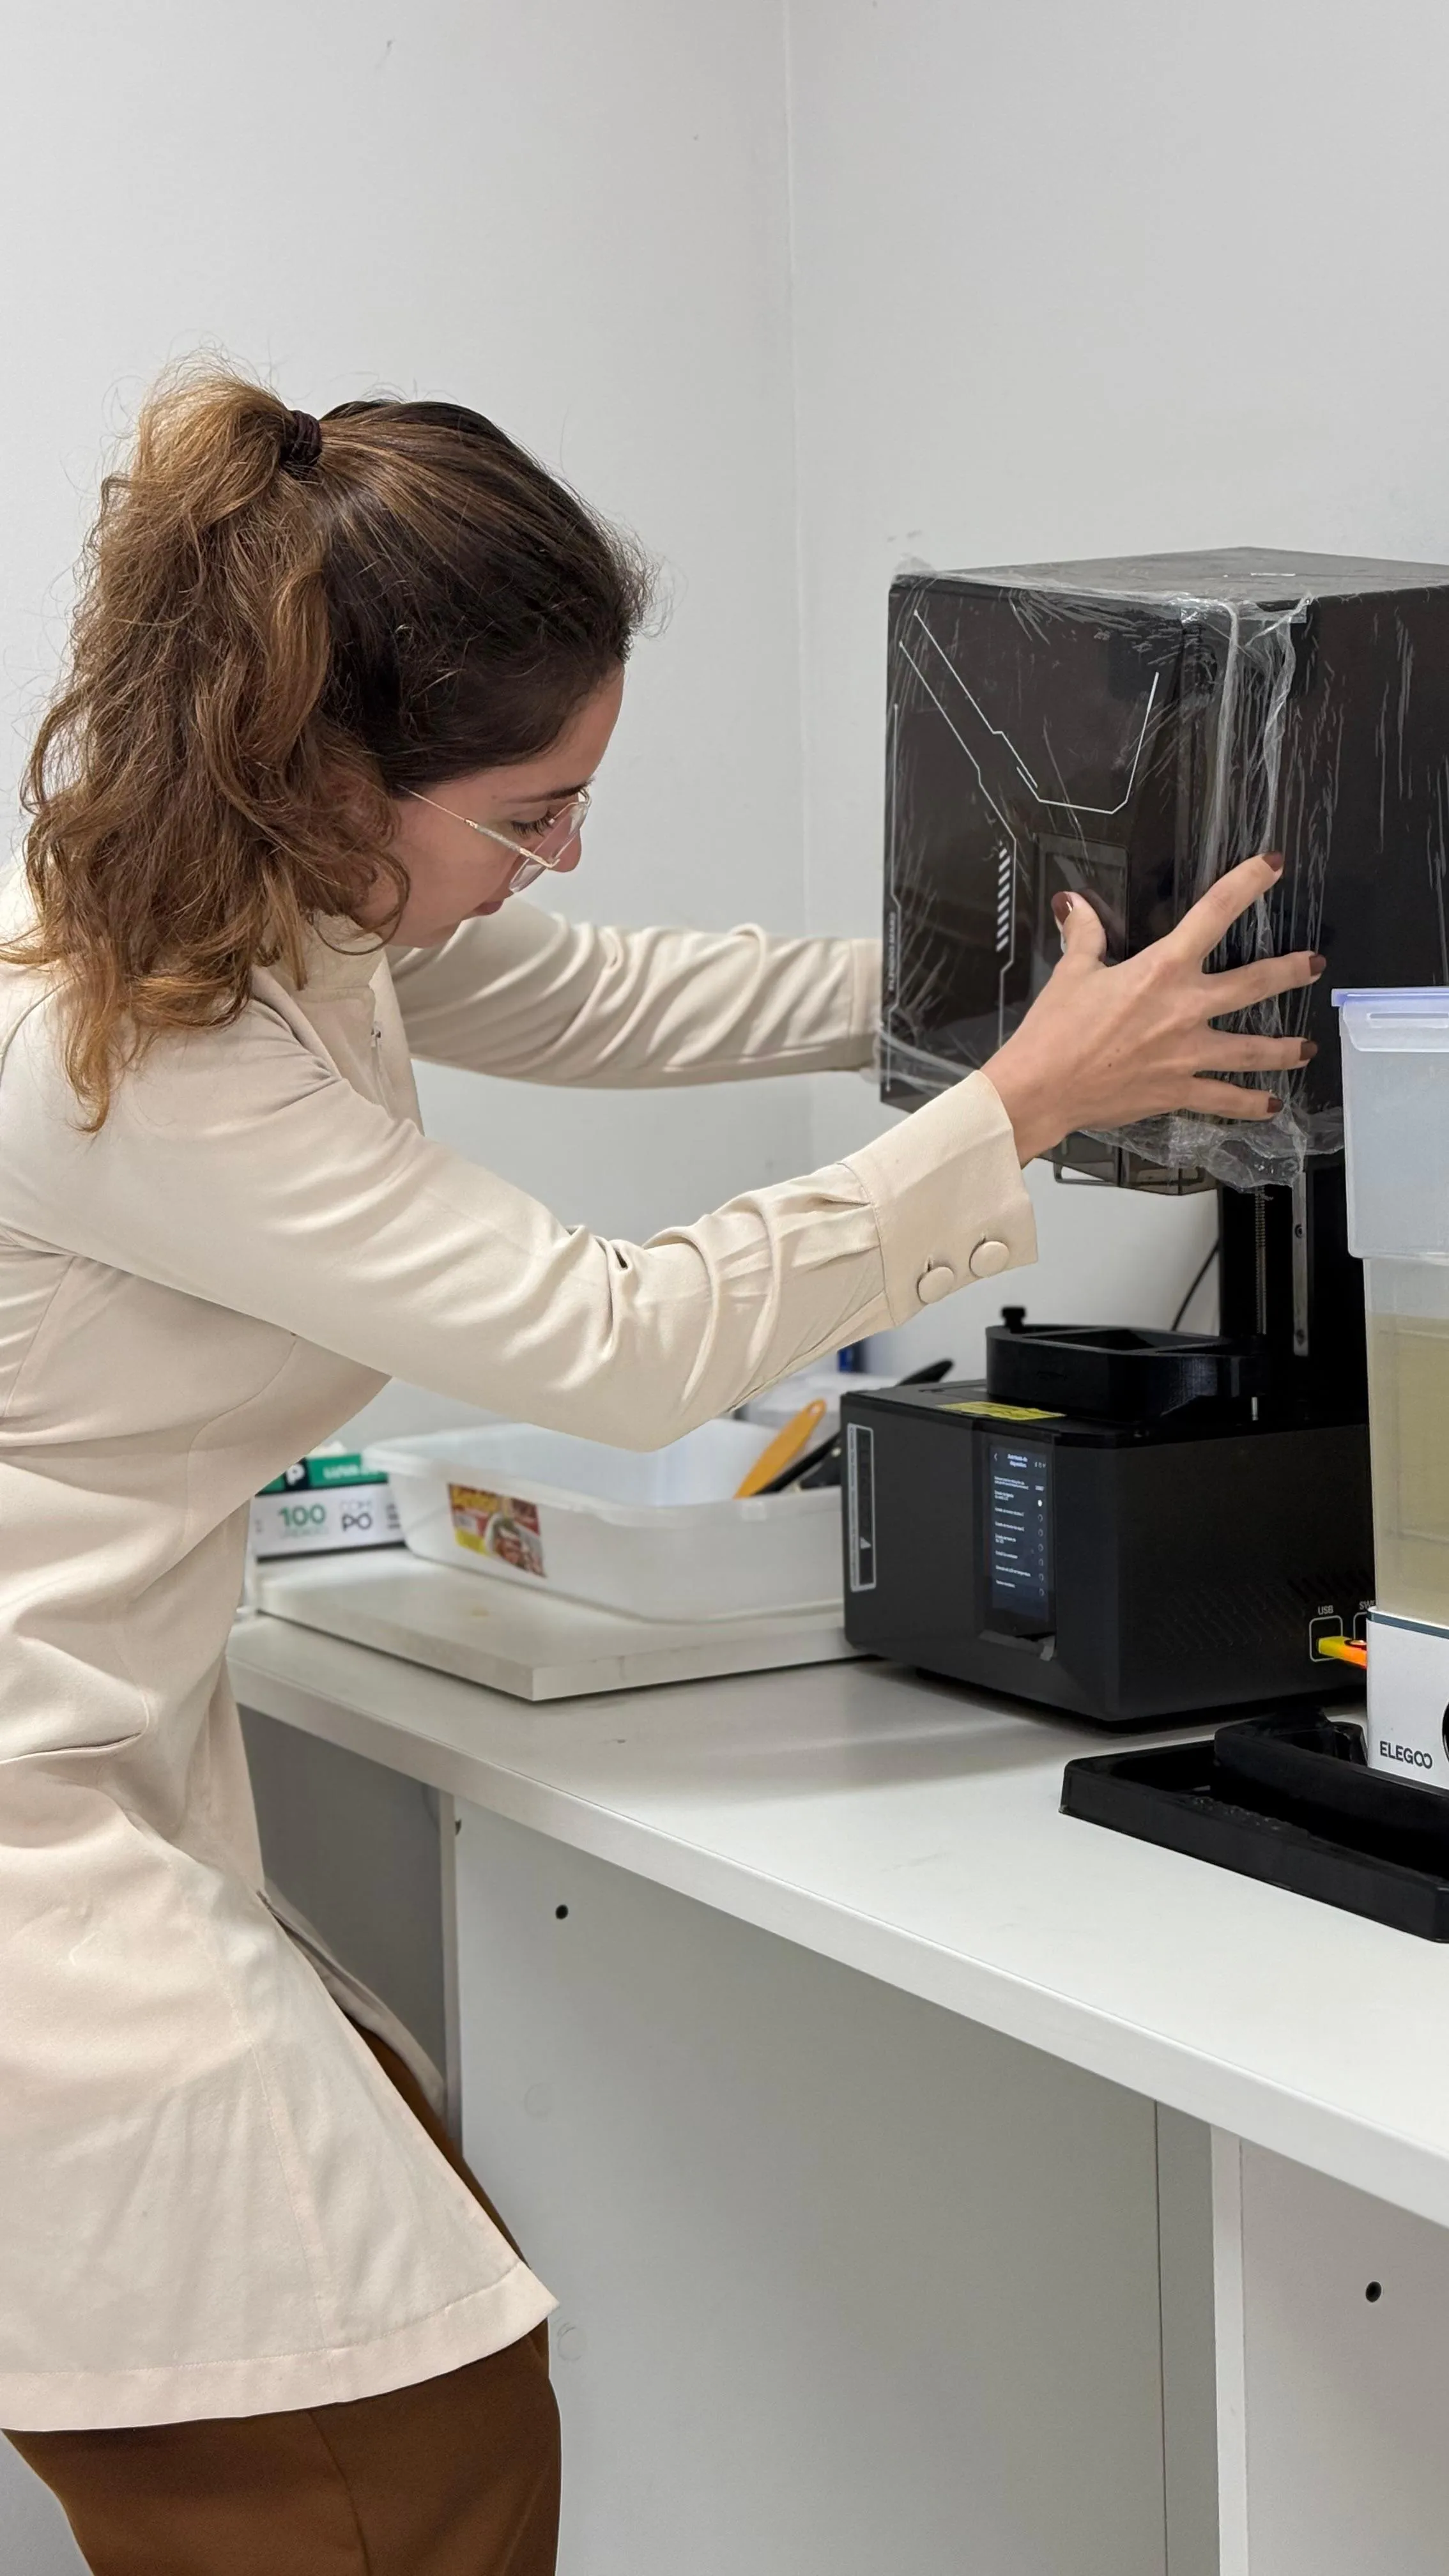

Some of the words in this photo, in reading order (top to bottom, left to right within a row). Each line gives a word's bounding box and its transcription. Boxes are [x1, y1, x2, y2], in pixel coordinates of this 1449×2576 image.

[278, 1504, 325, 1526] 100
[1317, 1605, 1334, 1615] USB
[1379, 1740, 1433, 1769] ELEGOO
